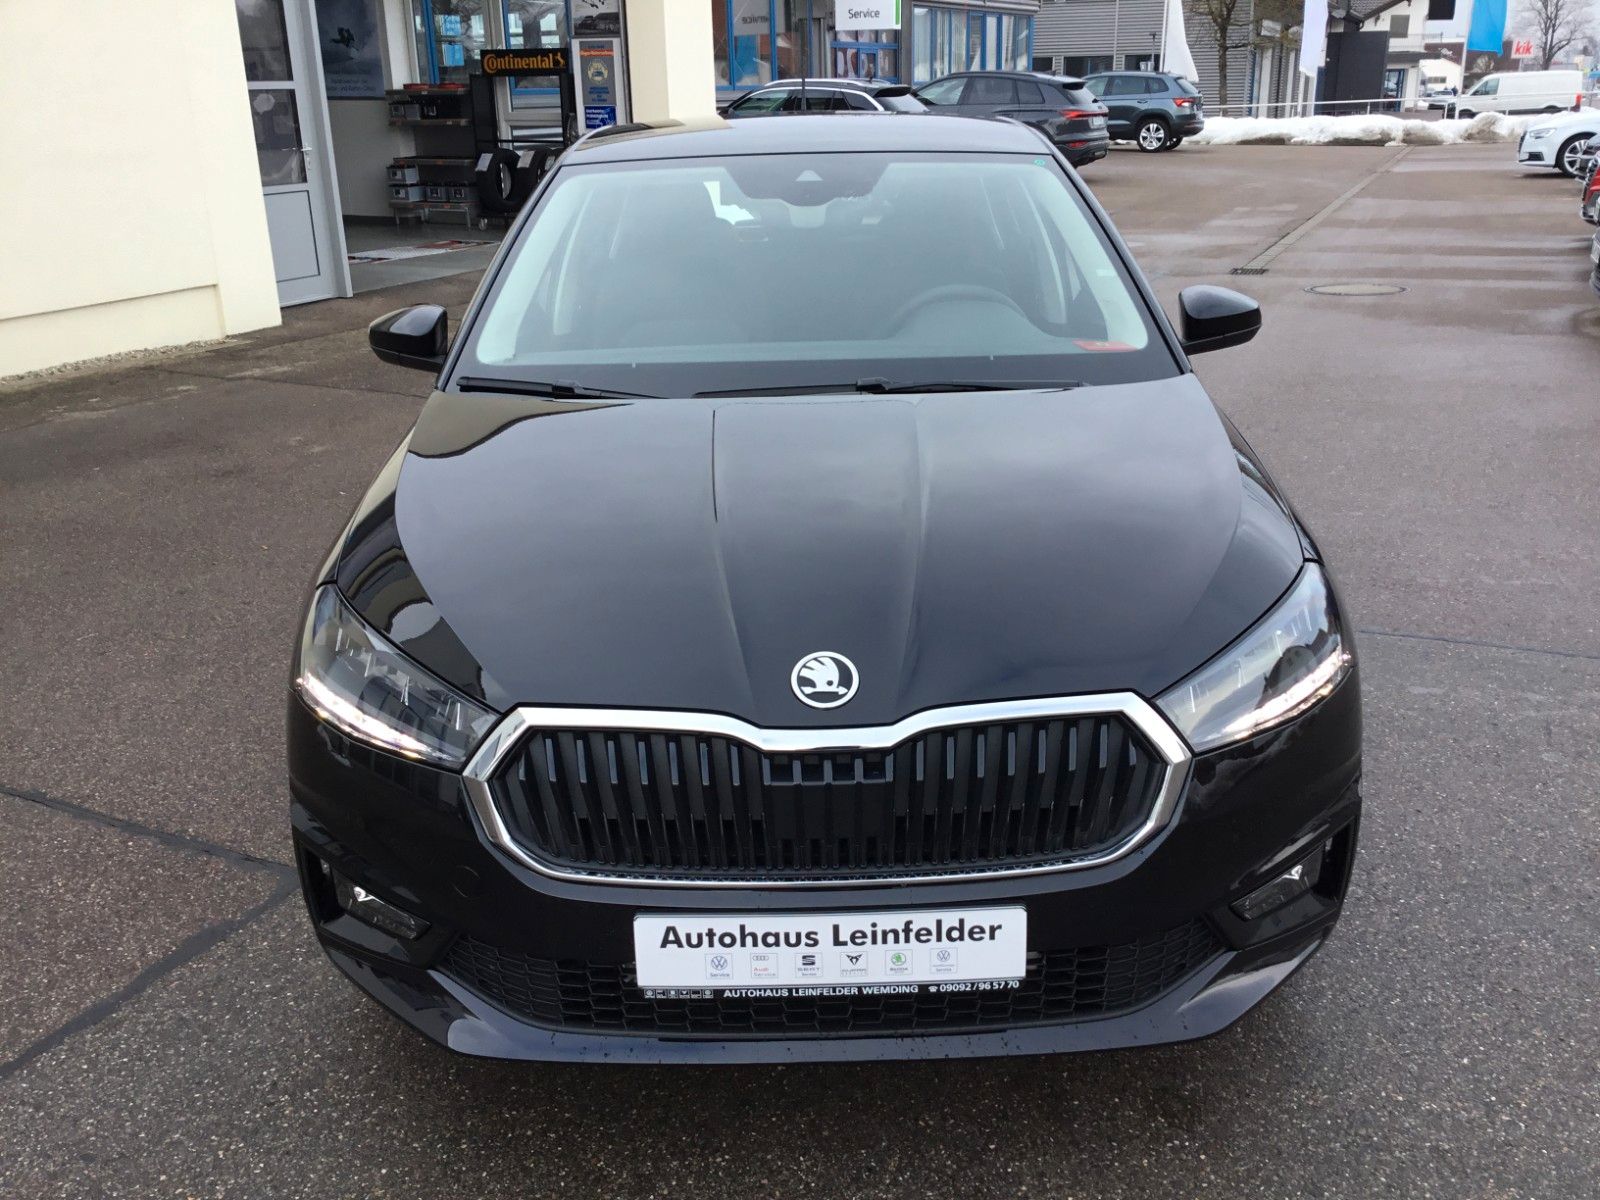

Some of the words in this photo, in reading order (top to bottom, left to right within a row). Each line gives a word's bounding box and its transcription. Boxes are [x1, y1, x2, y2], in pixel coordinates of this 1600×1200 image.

[848, 8, 880, 19] Service
[1514, 40, 1533, 55] kik
[483, 53, 554, 73] Continental
[660, 924, 820, 949] Autohaus
[832, 917, 1003, 947] Leinfelder
[723, 987, 789, 998] AUTOHAUS
[792, 986, 859, 997] LEINFELDER
[861, 984, 919, 995] WEMDING
